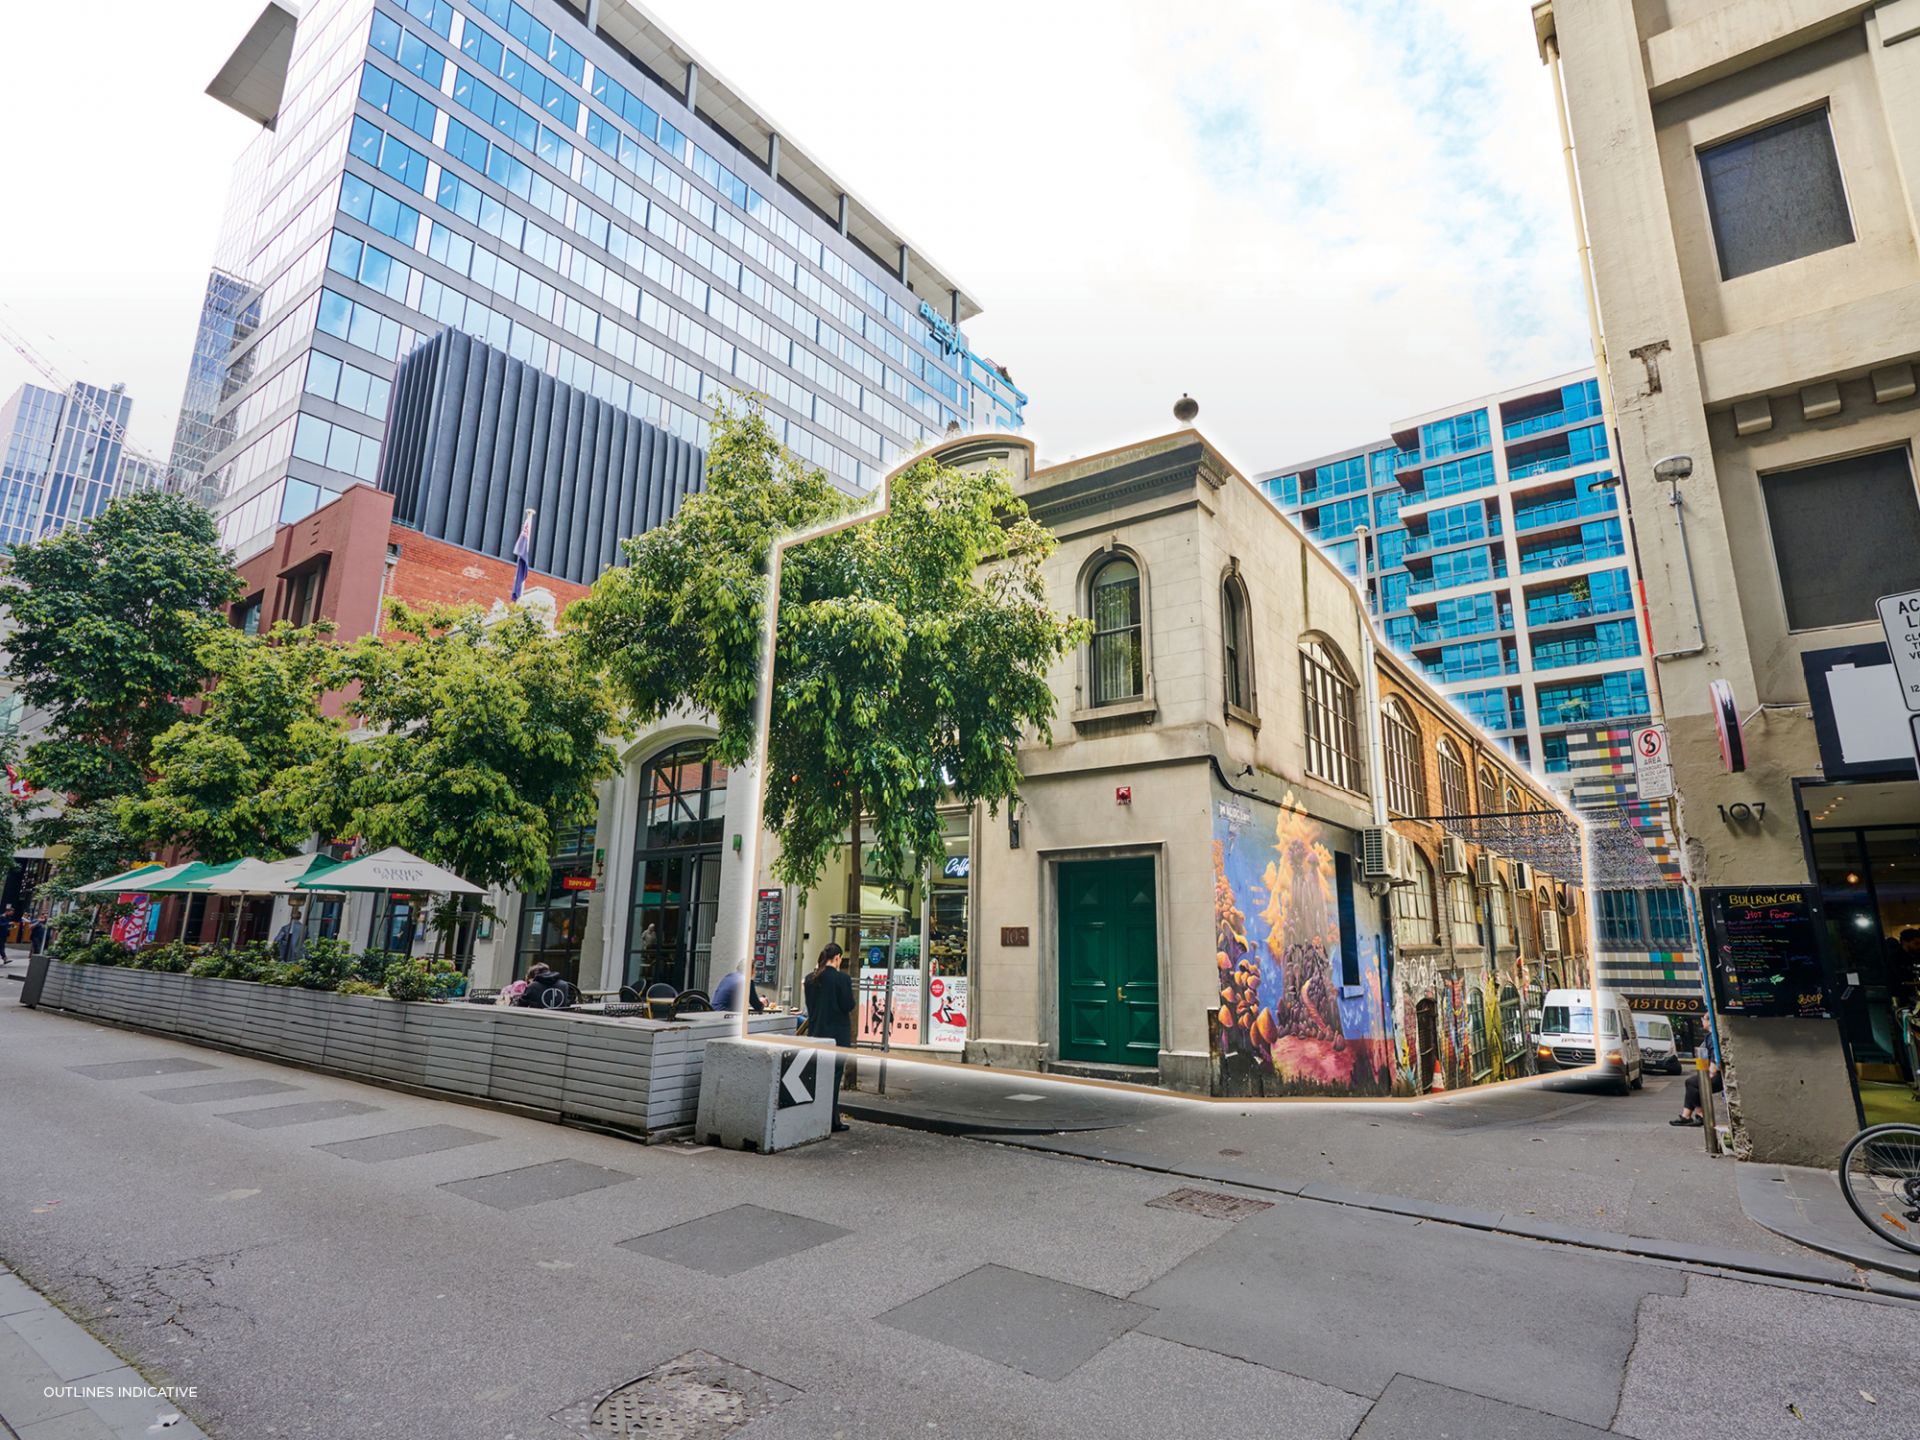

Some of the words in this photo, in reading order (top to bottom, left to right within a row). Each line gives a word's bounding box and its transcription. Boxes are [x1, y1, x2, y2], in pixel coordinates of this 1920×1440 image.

[1906, 615, 1920, 628] L
[1643, 756, 1662, 766] AREA
[1717, 802, 1766, 824] 107
[944, 857, 970, 877] Coffe
[1629, 998, 1699, 1011] ASTUSO
